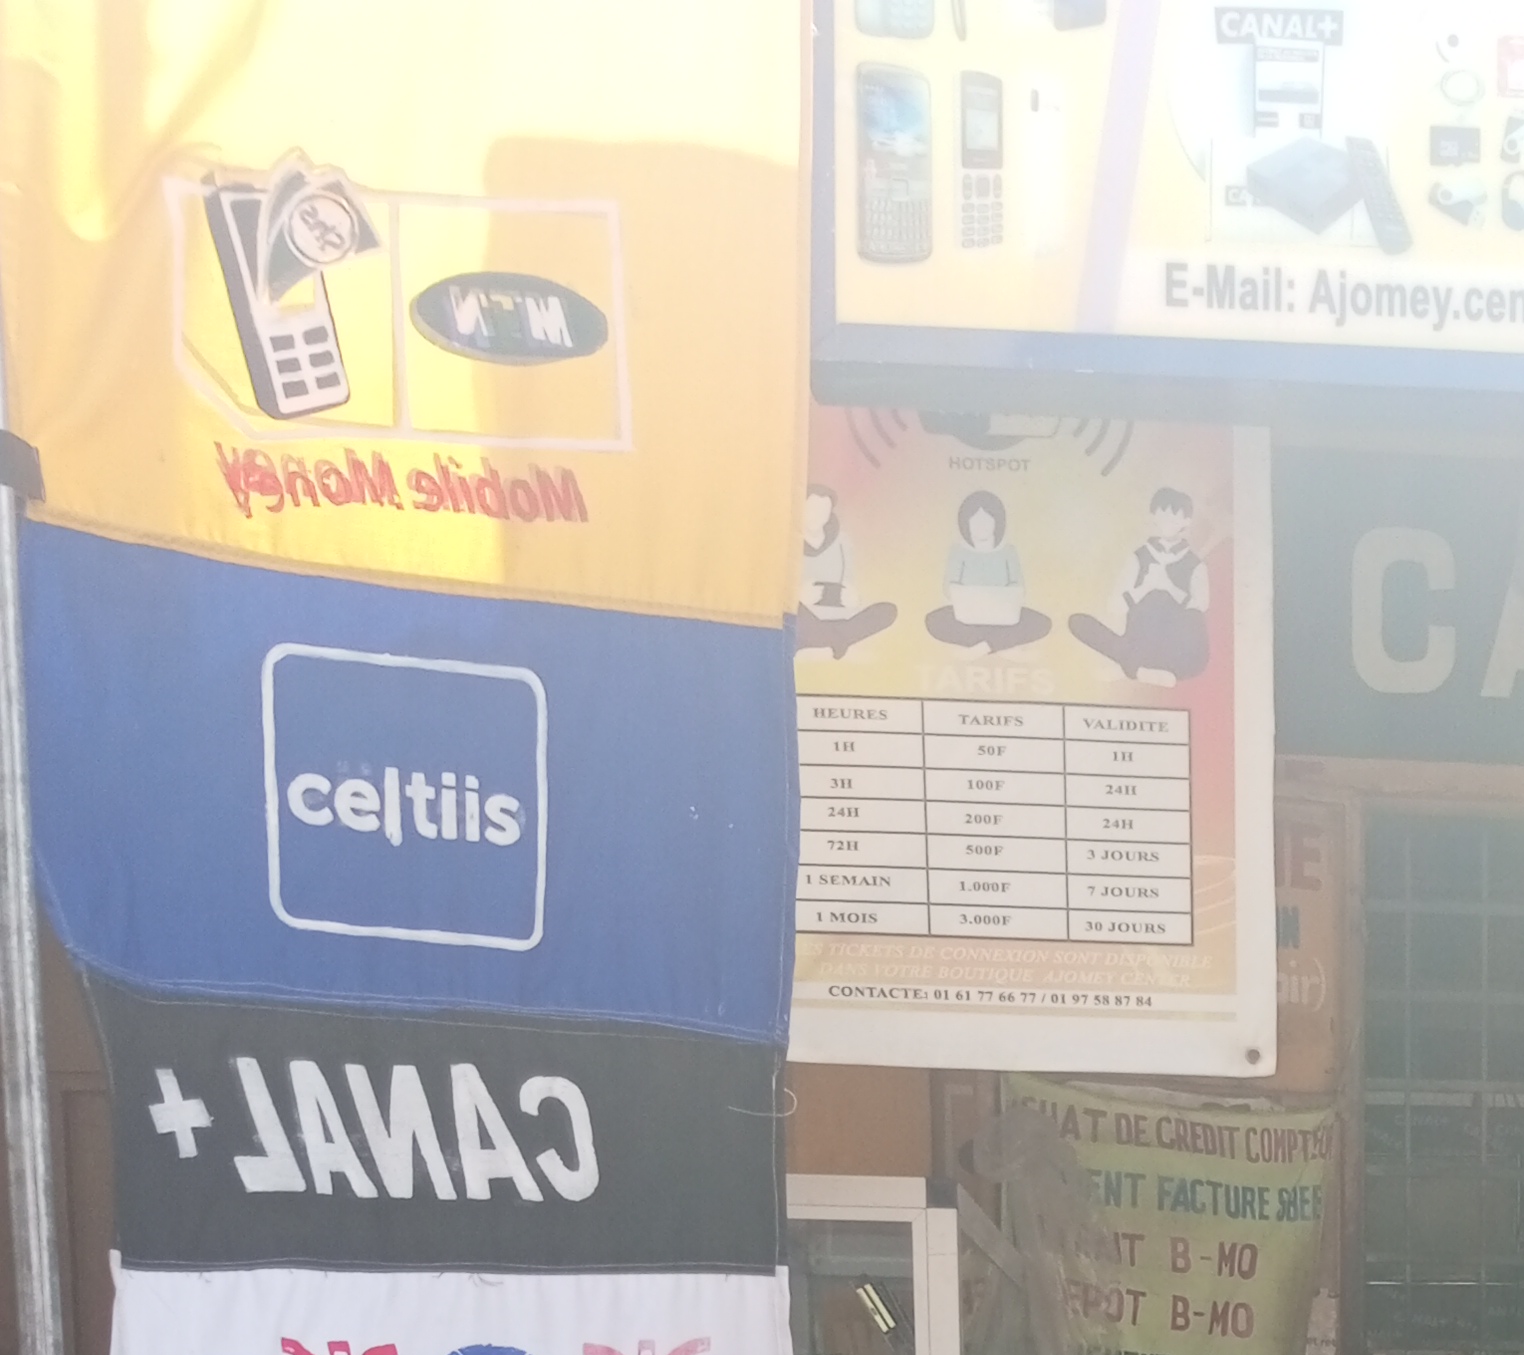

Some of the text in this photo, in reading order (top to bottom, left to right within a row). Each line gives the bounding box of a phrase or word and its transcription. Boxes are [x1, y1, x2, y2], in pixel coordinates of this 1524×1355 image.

[1219, 10, 1339, 41] CANAL+
[1164, 262, 1296, 314] E-Mail:
[948, 456, 1031, 473] HOTSPOT
[914, 664, 1056, 696] TARIFS
[812, 706, 1170, 734] HEURES TARIFS VALIDITE
[833, 740, 1134, 763] 1H 50F 1H
[829, 777, 1138, 797] 3H 100F 24H
[286, 766, 524, 847] celtiis
[827, 806, 1134, 831] 24H 200F 24H
[826, 840, 1160, 864] 72H 500F 3 JOURS
[805, 874, 1160, 900] 1 SEMAIN 1.000F 7 JOURS
[816, 911, 1167, 935] 1 MOIS 3.000F 30 JOURS
[828, 943, 904, 960] TICKETS
[908, 945, 936, 960] DE
[940, 946, 1048, 964] CONNEXION
[1054, 950, 1103, 966] SONT
[937, 965, 1034, 984] BOUTIQUE
[933, 989, 951, 1002] 01
[955, 990, 972, 1003] 61
[977, 991, 994, 1004] 77
[998, 992, 1016, 1005] 66
[1020, 993, 1037, 1005] 77
[1050, 993, 1067, 1006] 01
[1072, 994, 1089, 1007] 97
[1093, 994, 1111, 1007] 58
[1115, 995, 1132, 1008] 87
[1135, 996, 1153, 1009] 84
[1114, 1112, 1240, 1160] DE CREDIT
[1156, 1173, 1270, 1221] FACTURE
